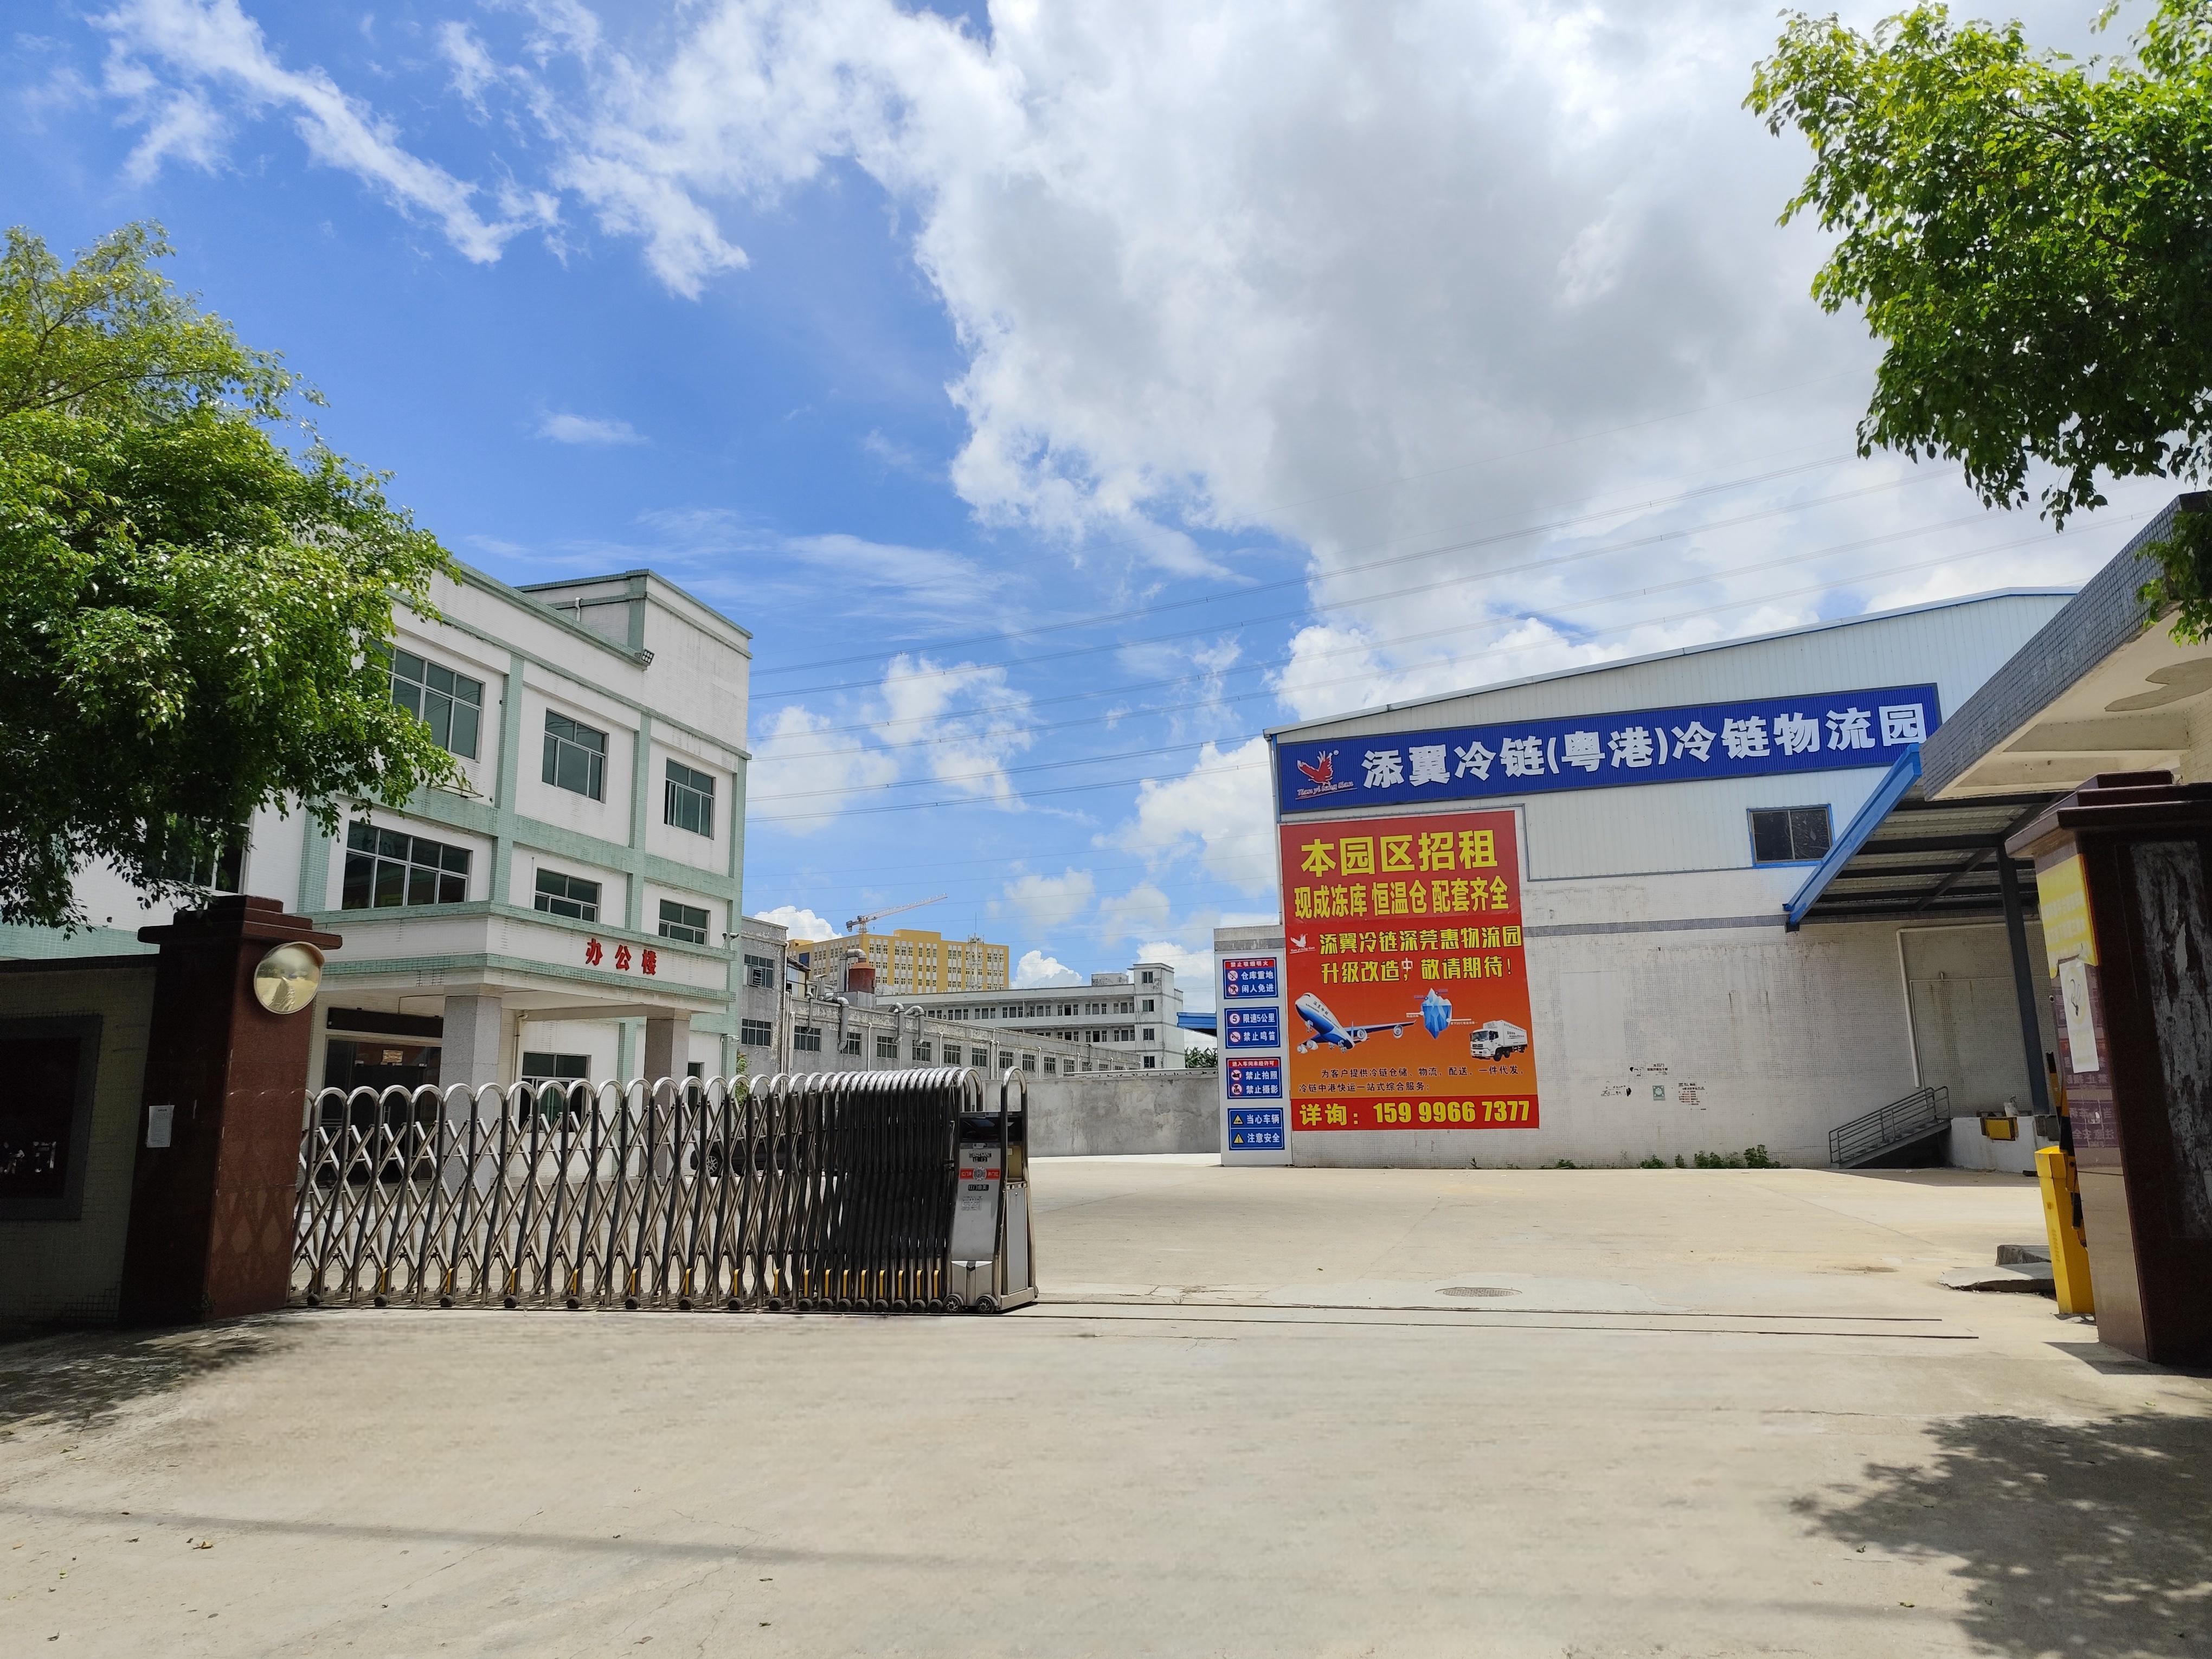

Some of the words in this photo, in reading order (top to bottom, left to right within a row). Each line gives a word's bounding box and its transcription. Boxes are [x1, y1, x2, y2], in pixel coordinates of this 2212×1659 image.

[1362, 702, 1927, 788] 添翼冷链(粤港)冷链物流园
[1301, 829, 1498, 878] 本园区招租
[1294, 883, 1367, 919] 现成冻库
[1372, 879, 1427, 916] 恒温仓
[1432, 875, 1509, 914] 配套齐全
[1319, 925, 1522, 955] 添翼冷链深莞惠物流园
[585, 937, 657, 975] 办公楼
[1241, 970, 1274, 980] 仓库重地
[1242, 983, 1275, 993] 闲人免进
[1243, 1013, 1275, 1023] 限速5公里
[1244, 1031, 1276, 1041] 禁止鸣笛
[1245, 1071, 1278, 1080] 禁止拍照
[1246, 1085, 1278, 1094] 禁止摄影
[1373, 1102, 1412, 1123] 159
[1418, 1101, 1476, 1122] 9966
[1481, 1100, 1530, 1122] 7377
[1246, 1114, 1279, 1124] 当心车辆
[1247, 1133, 1280, 1143] 注意安全
